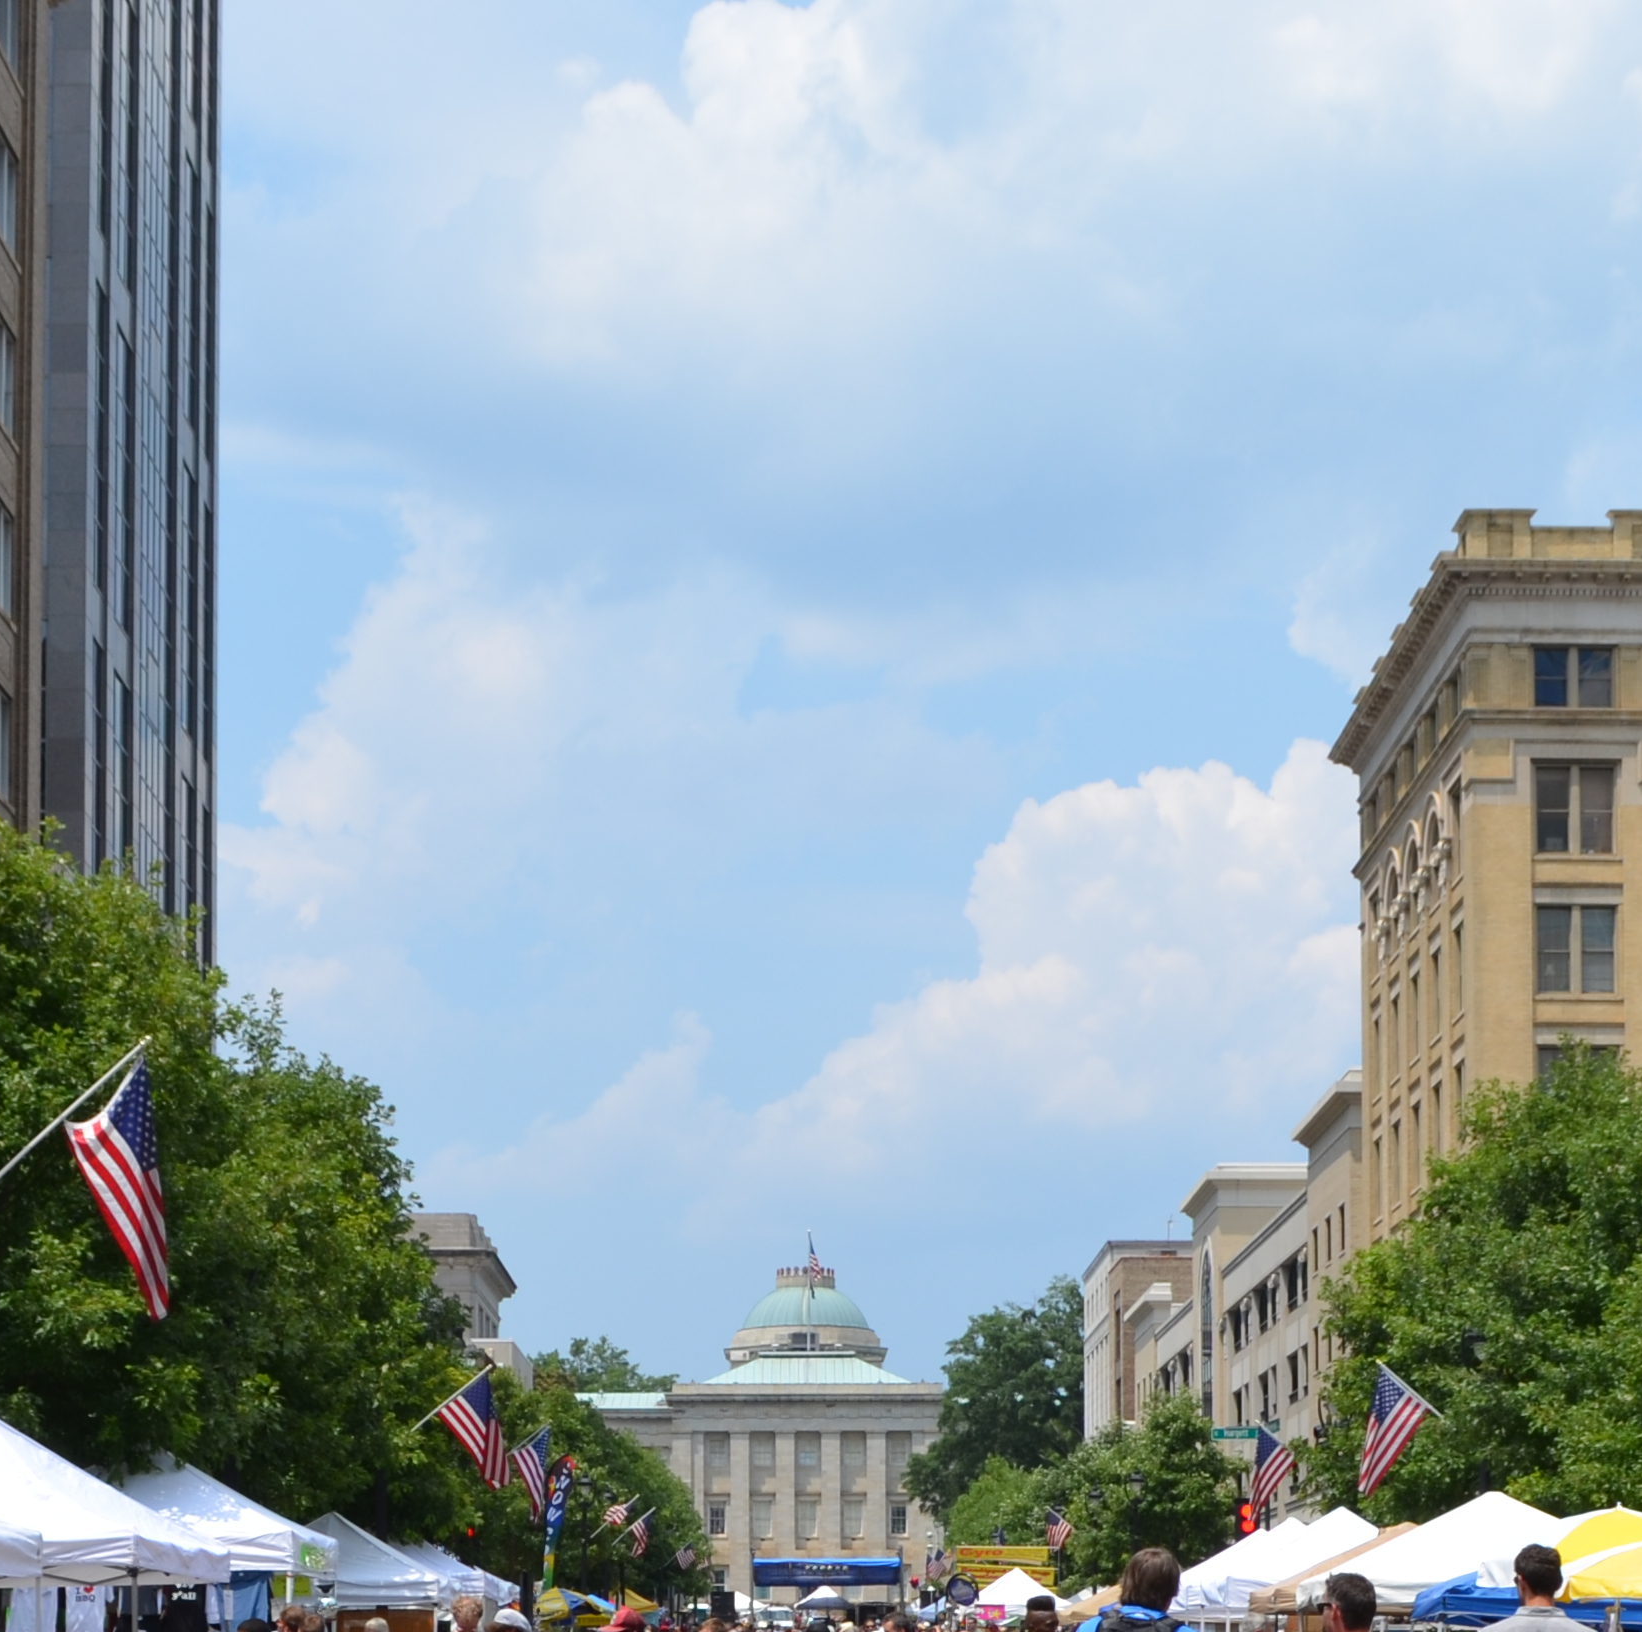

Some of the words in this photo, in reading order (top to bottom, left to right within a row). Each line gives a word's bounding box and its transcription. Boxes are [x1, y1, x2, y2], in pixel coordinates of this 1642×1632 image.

[959, 1548, 1004, 1557] Gyro
[75, 1593, 96, 1603] BBQ
[171, 1591, 197, 1601] y'all
